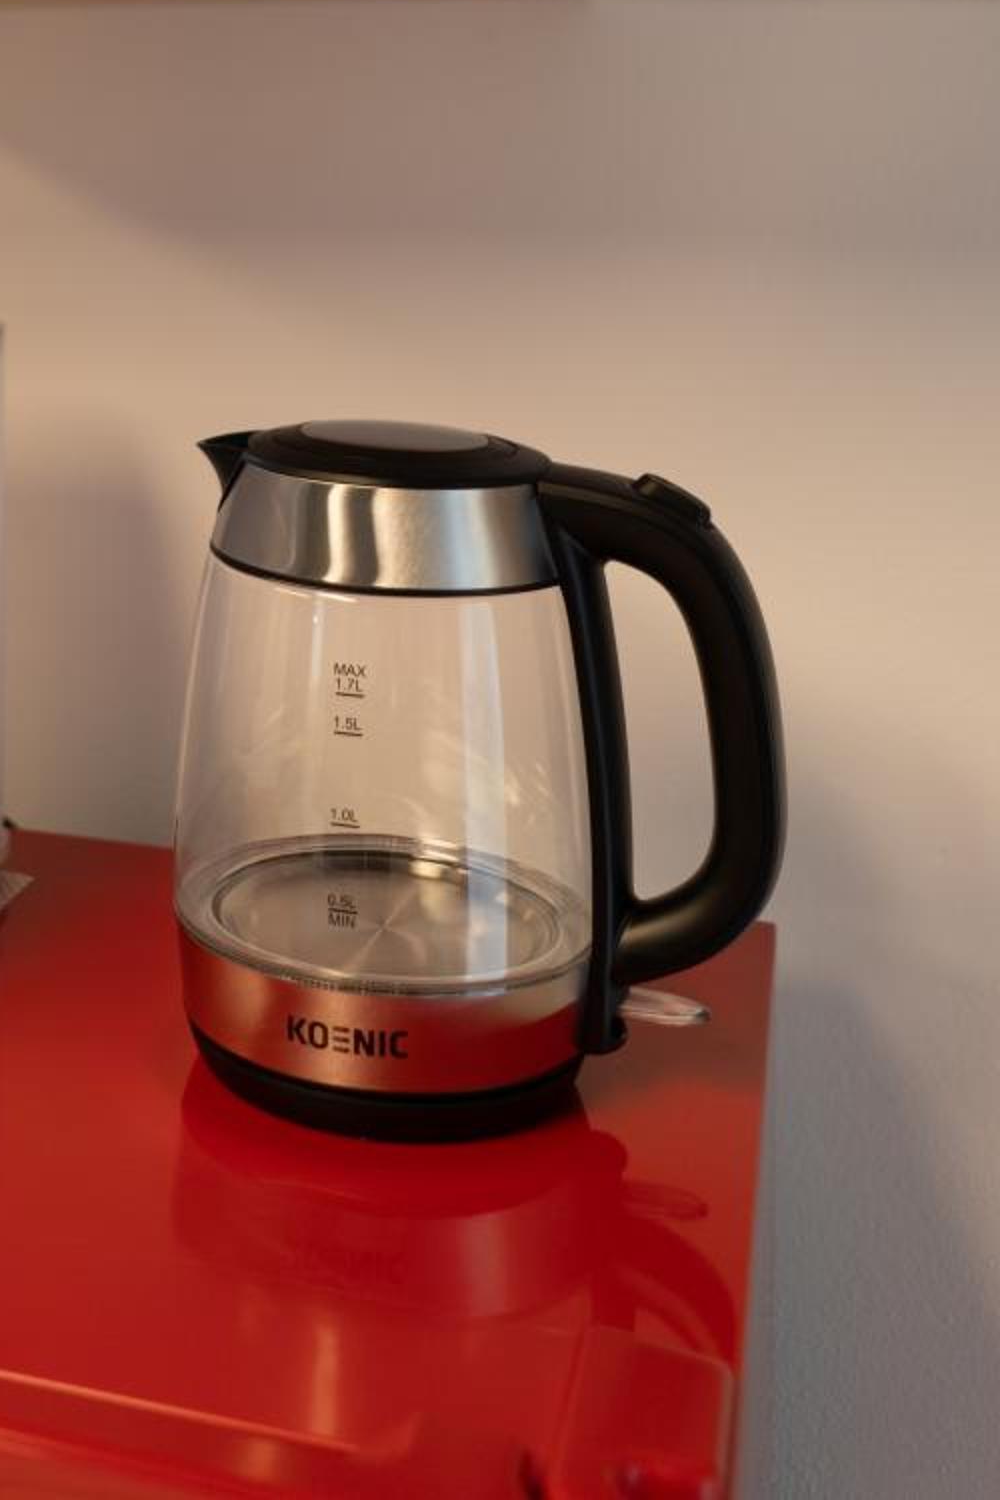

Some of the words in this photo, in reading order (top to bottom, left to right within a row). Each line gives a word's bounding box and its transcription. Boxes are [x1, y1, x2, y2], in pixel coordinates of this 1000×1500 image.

[333, 662, 367, 677] MAX
[335, 677, 363, 693] 1.7L
[333, 715, 362, 731] 1.5L
[330, 808, 358, 823] 1.0L
[327, 893, 356, 909] 0.5L
[327, 912, 356, 929] MIN
[286, 1014, 409, 1060] KOENIC
